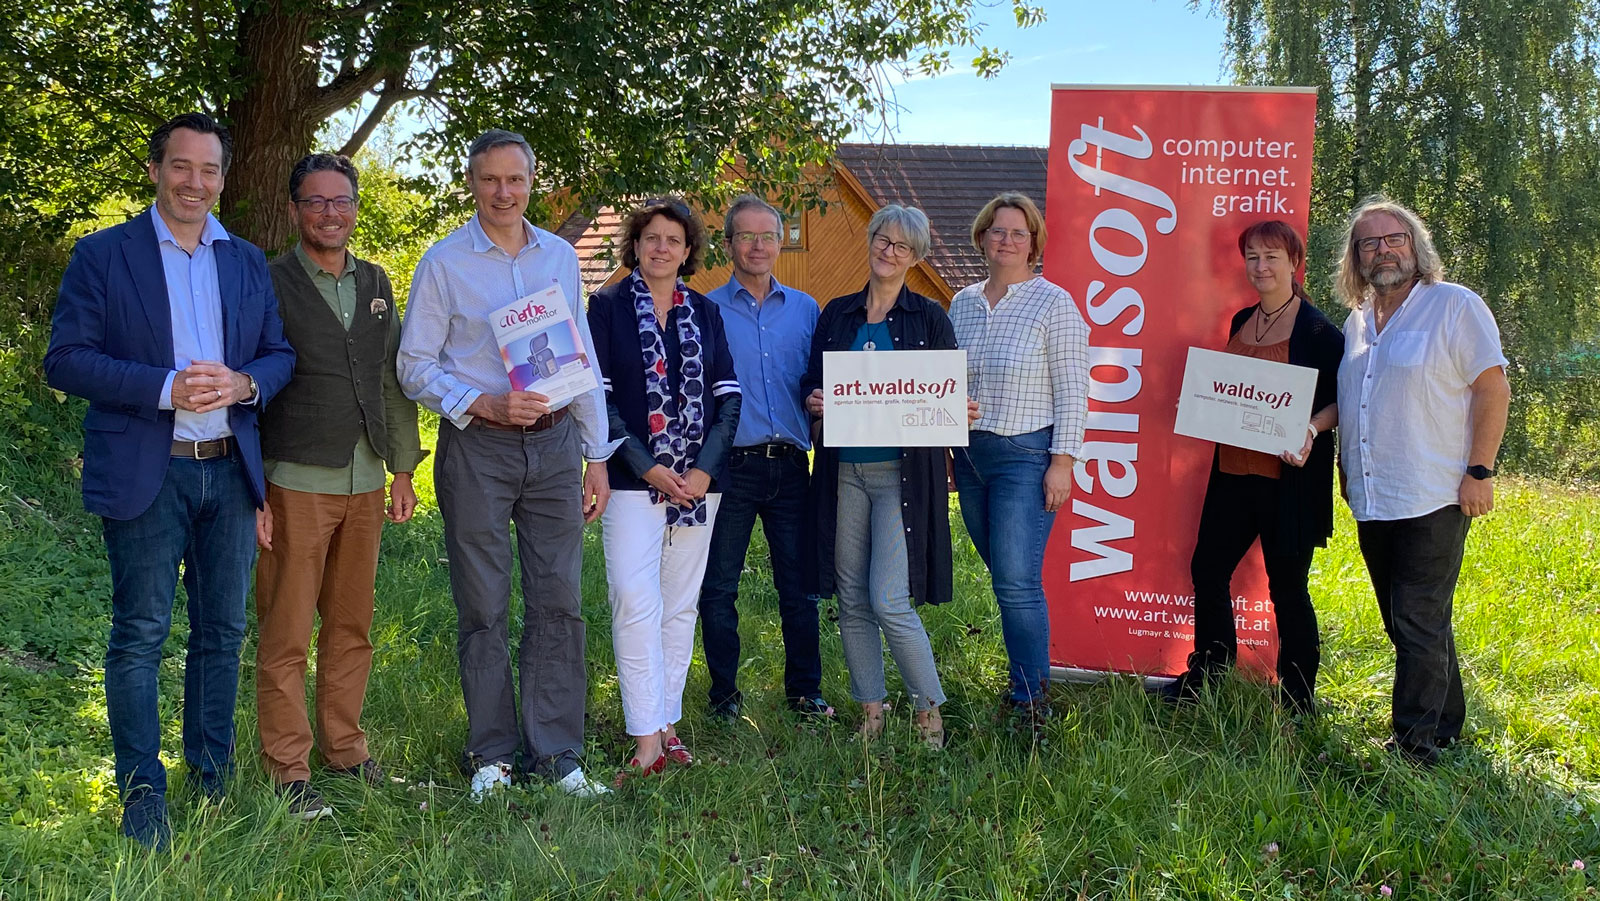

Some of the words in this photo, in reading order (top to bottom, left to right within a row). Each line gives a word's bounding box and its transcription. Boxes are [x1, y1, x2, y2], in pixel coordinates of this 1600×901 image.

[1163, 137, 1297, 162] computer.
[1181, 161, 1296, 187] internet.
[1212, 190, 1294, 217] grafik.
[526, 308, 558, 327] monitor
[1213, 381, 1293, 409] waldsoft
[1125, 590, 1271, 614] www.waft.at
[1094, 605, 1270, 632] www.art.waft.at
[1128, 627, 1162, 638] Lugmayr
[1163, 630, 1171, 638] &
[1172, 631, 1195, 642] Wagn
